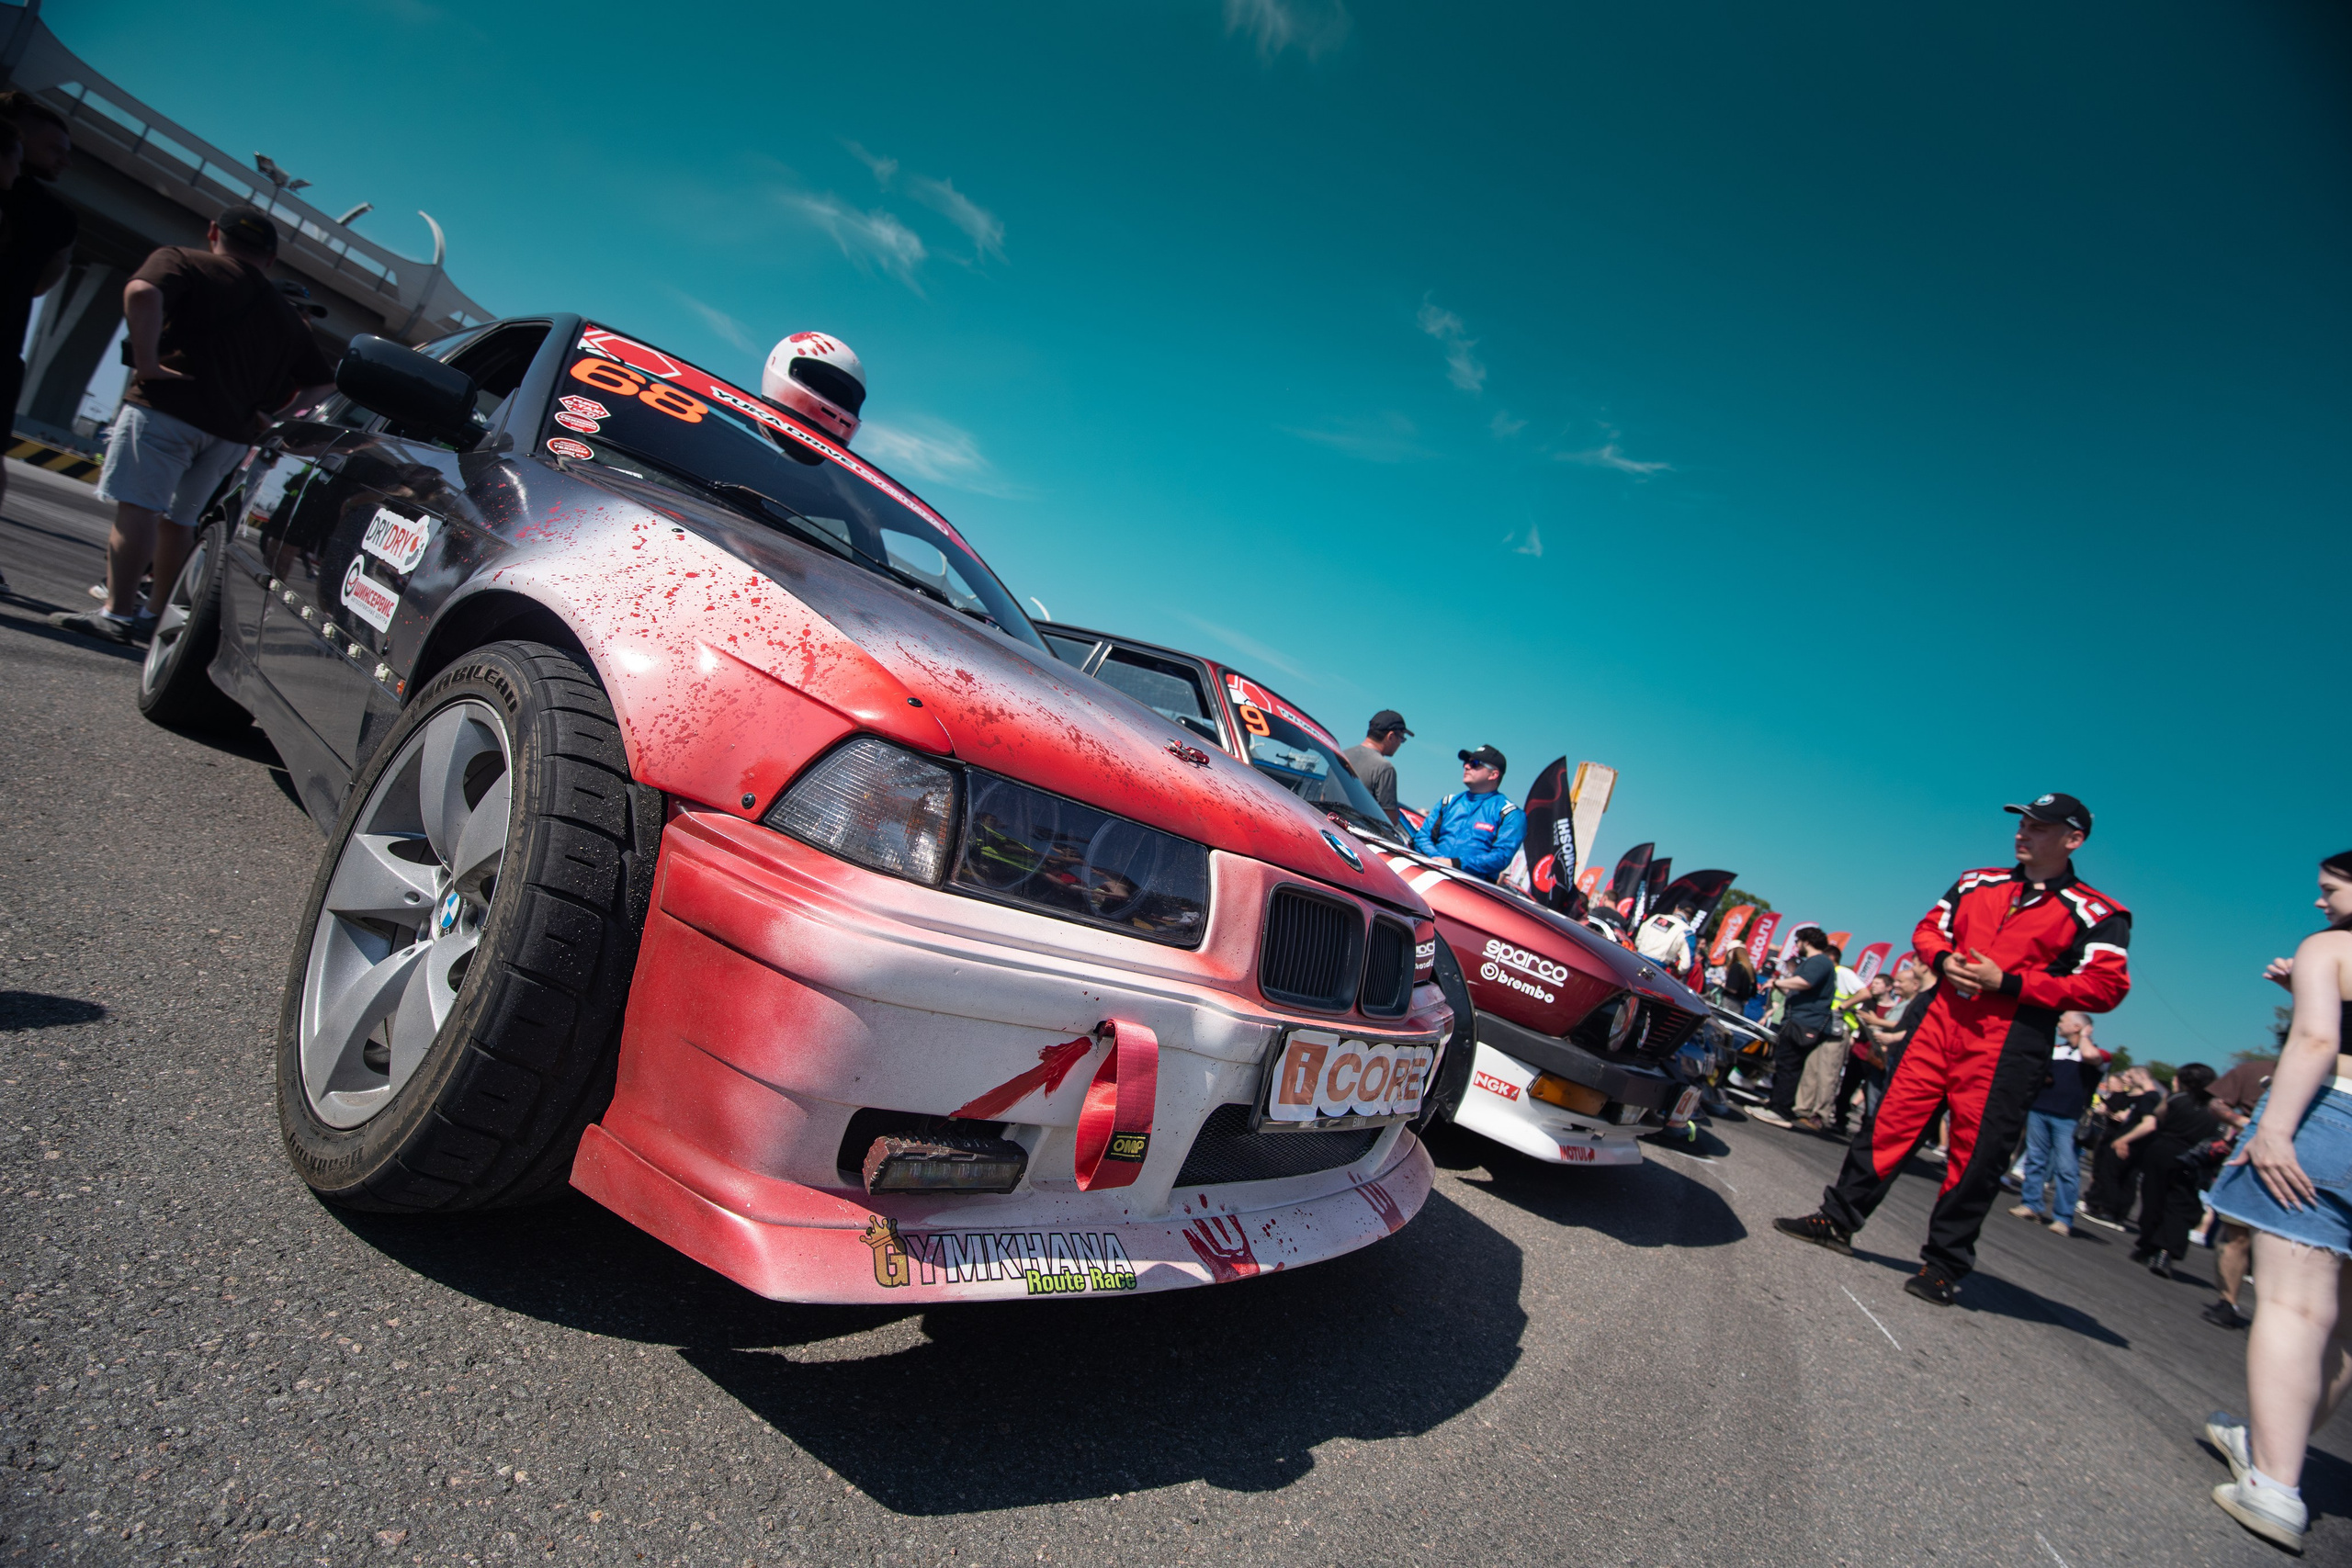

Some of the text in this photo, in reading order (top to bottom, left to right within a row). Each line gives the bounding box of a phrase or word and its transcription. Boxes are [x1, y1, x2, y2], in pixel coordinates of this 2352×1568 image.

[570, 358, 708, 423] 68
[715, 388, 782, 428] YUKA
[786, 424, 854, 468] DRIVE
[366, 516, 414, 560] DRYDRY
[354, 580, 395, 618] ШИНСЕРВИС
[1240, 705, 1271, 737] 9
[1486, 939, 1567, 983] sparco
[1497, 969, 1555, 1004] brembo
[1326, 1053, 1427, 1102] CORE
[1475, 1072, 1510, 1095] NGK
[1352, 1117, 1367, 1128] BMW
[1113, 1139, 1145, 1154] OMP
[1559, 1145, 1588, 1162] MOTUL
[874, 1231, 1136, 1288] GYMKHANA
[1026, 1268, 1137, 1295] Route Race
